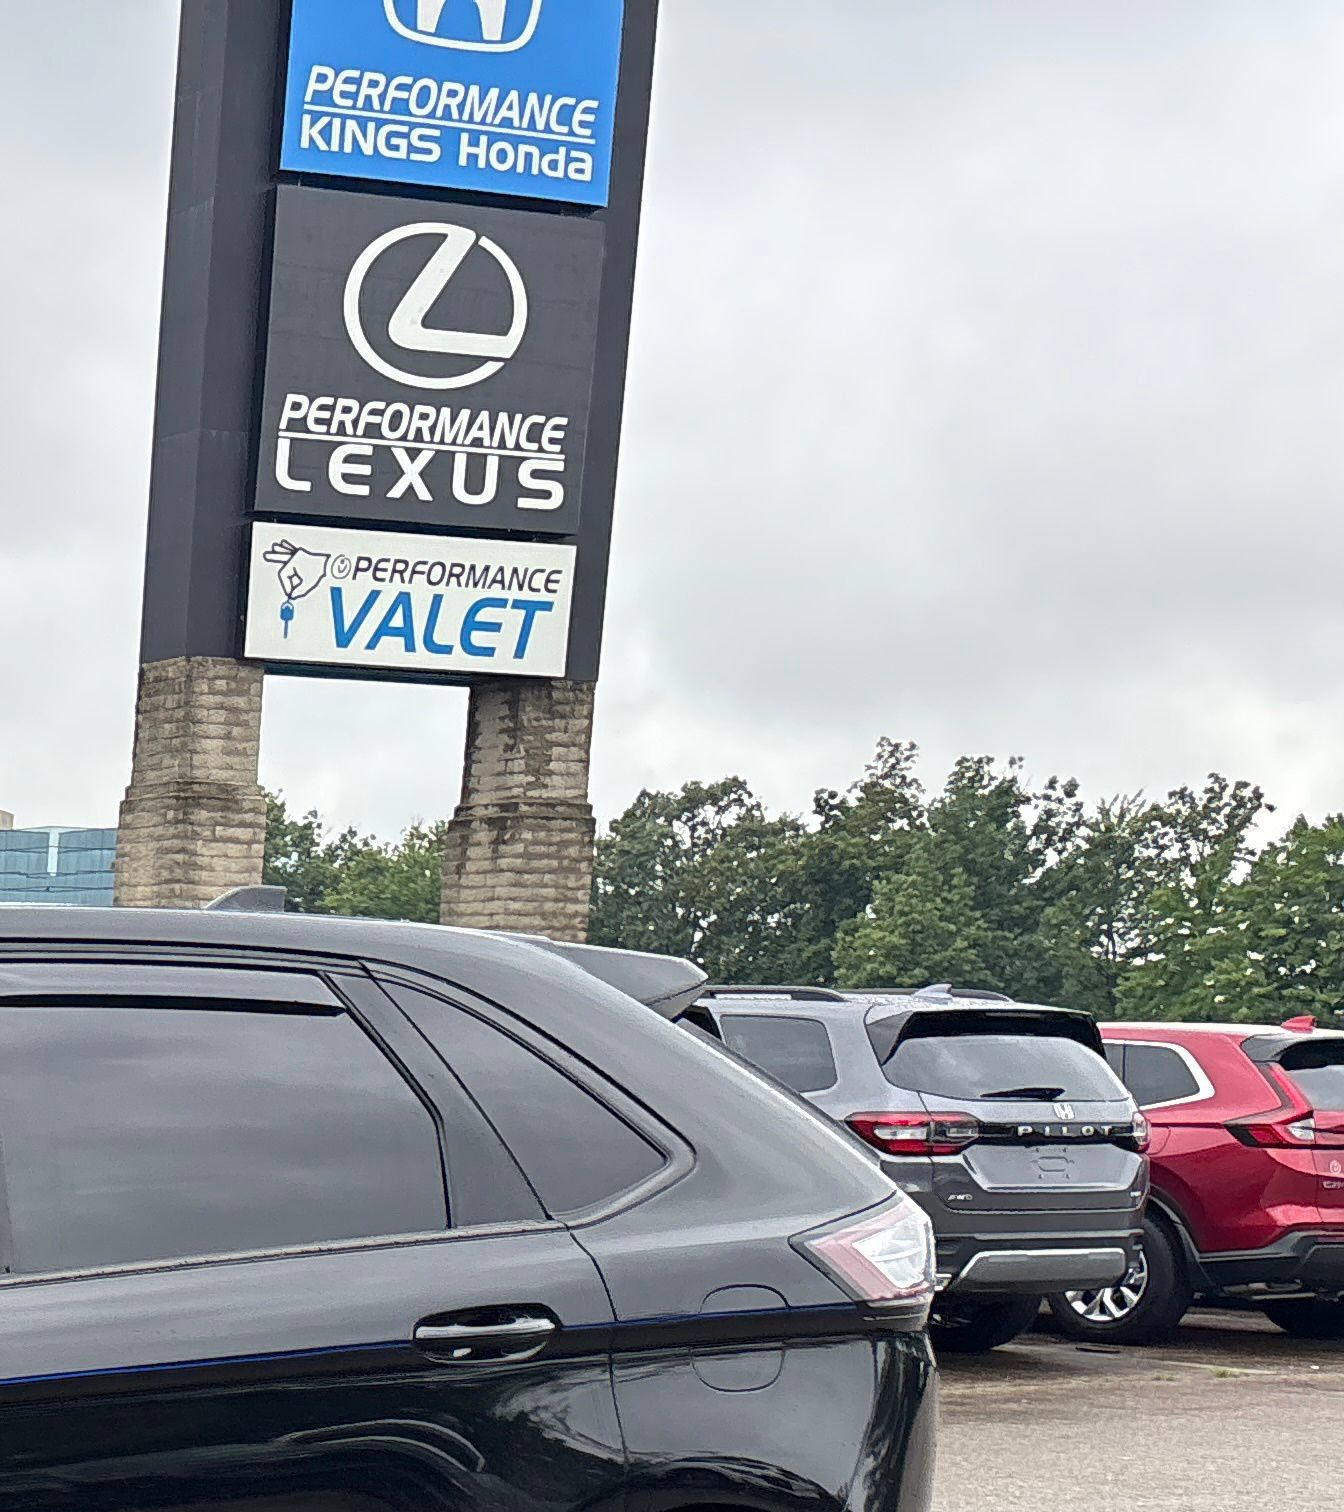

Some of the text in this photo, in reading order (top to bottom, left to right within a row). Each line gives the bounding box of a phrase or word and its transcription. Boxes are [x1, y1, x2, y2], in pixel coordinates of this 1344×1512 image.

[303, 64, 599, 136] PERFORMANCE
[300, 113, 593, 182] KINGS Honda
[278, 393, 568, 452] PERFORMANCE
[275, 438, 566, 511] LEXUS
[351, 556, 563, 594] PERFORMANCE
[329, 586, 554, 659] VALET
[1017, 1125, 1112, 1137] PILOT
